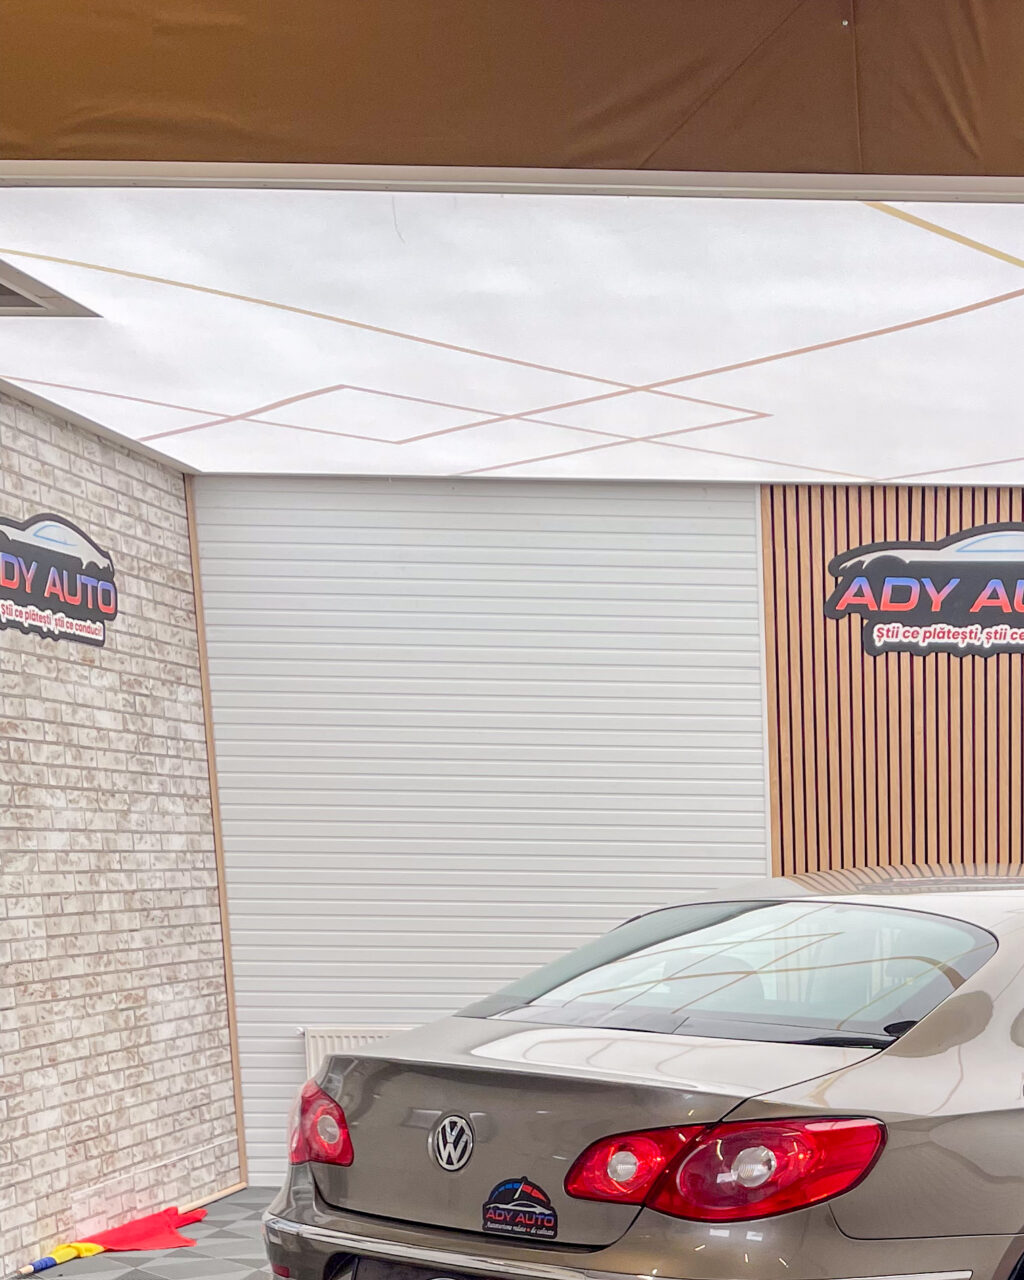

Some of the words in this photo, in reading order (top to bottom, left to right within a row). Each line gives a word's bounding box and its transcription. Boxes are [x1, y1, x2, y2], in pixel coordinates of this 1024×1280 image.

[0, 552, 38, 593] DY
[44, 566, 116, 614] AUTO
[836, 576, 960, 612] ADY
[15, 609, 23, 618] ce
[66, 620, 73, 630] ce
[876, 626, 899, 642] Știi
[902, 629, 920, 639] ce
[985, 628, 1008, 644] știi
[486, 1209, 513, 1221] ADY
[515, 1212, 555, 1226] AUTO
